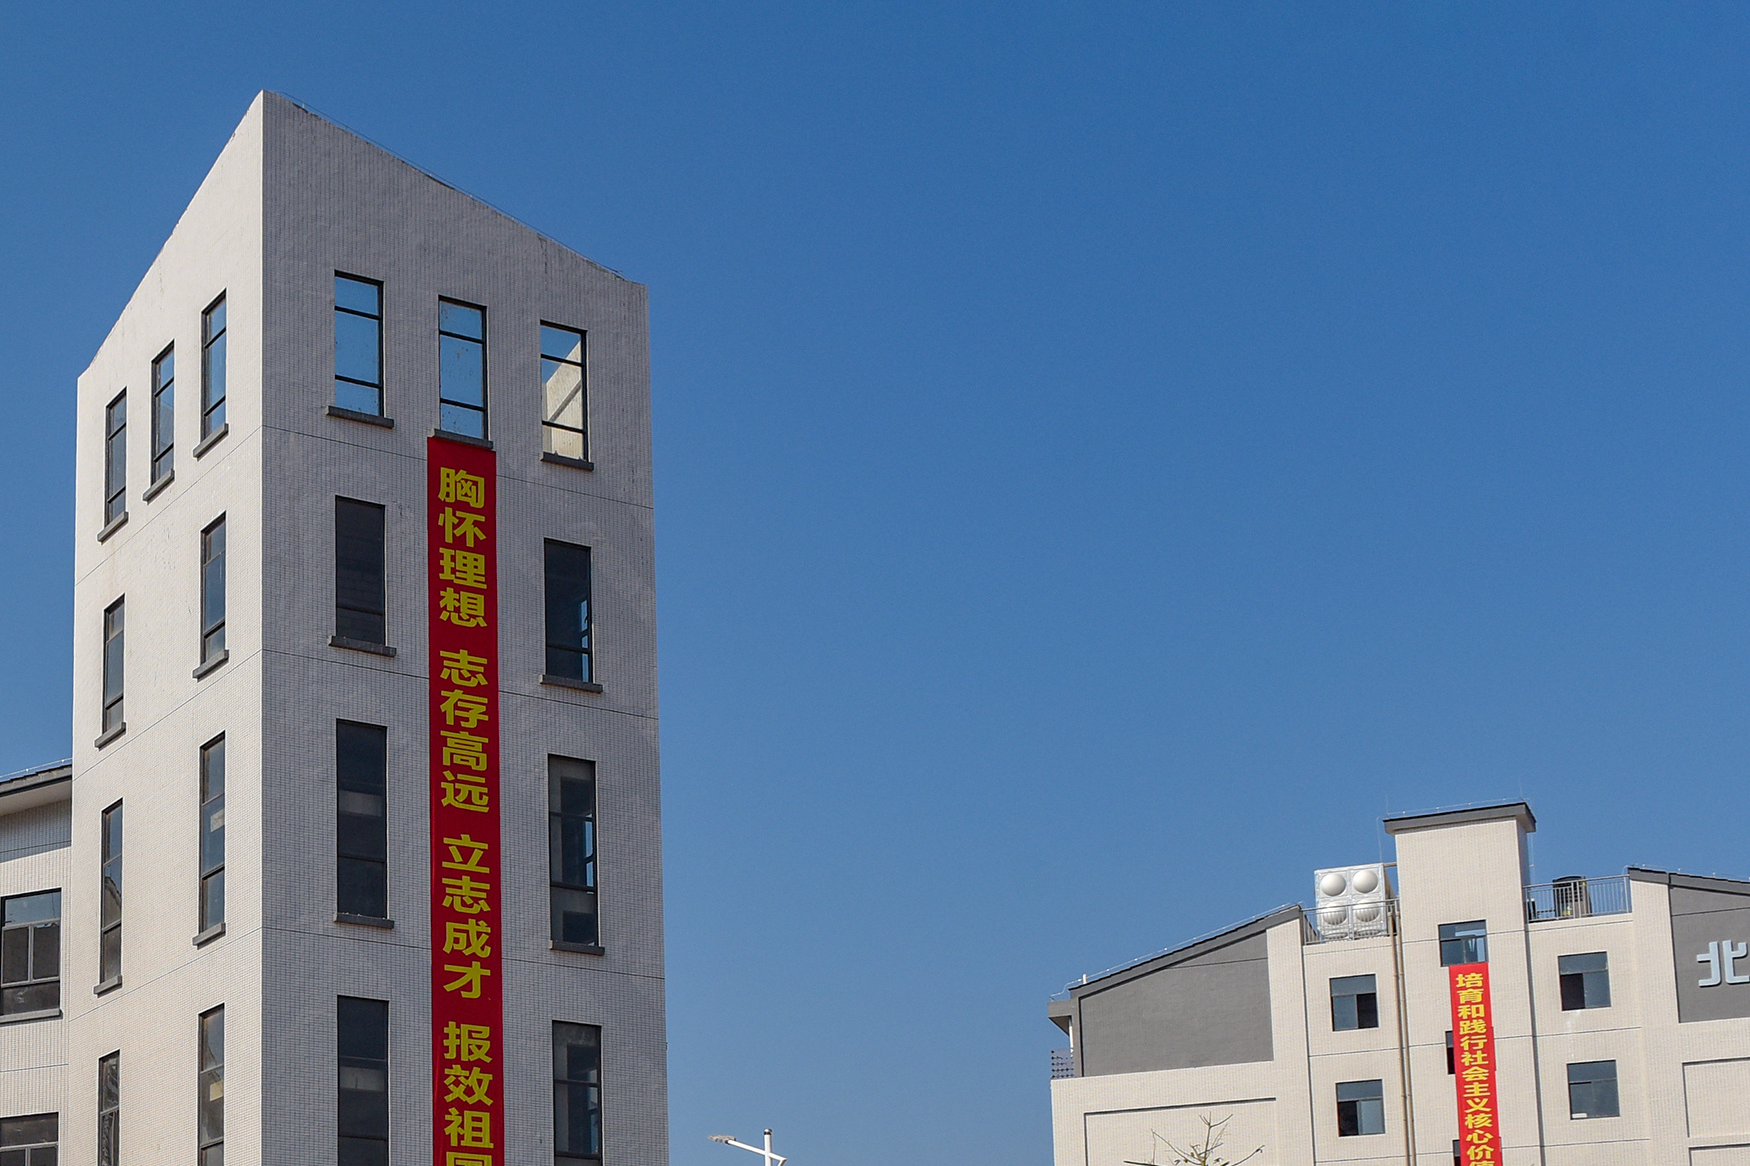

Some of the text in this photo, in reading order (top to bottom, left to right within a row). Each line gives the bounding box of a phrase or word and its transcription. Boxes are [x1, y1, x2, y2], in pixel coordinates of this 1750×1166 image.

[437, 467, 488, 628] 胸怀理想
[440, 649, 490, 813] 志存高远
[441, 834, 492, 999] 立志成才
[1696, 940, 1750, 986] 北
